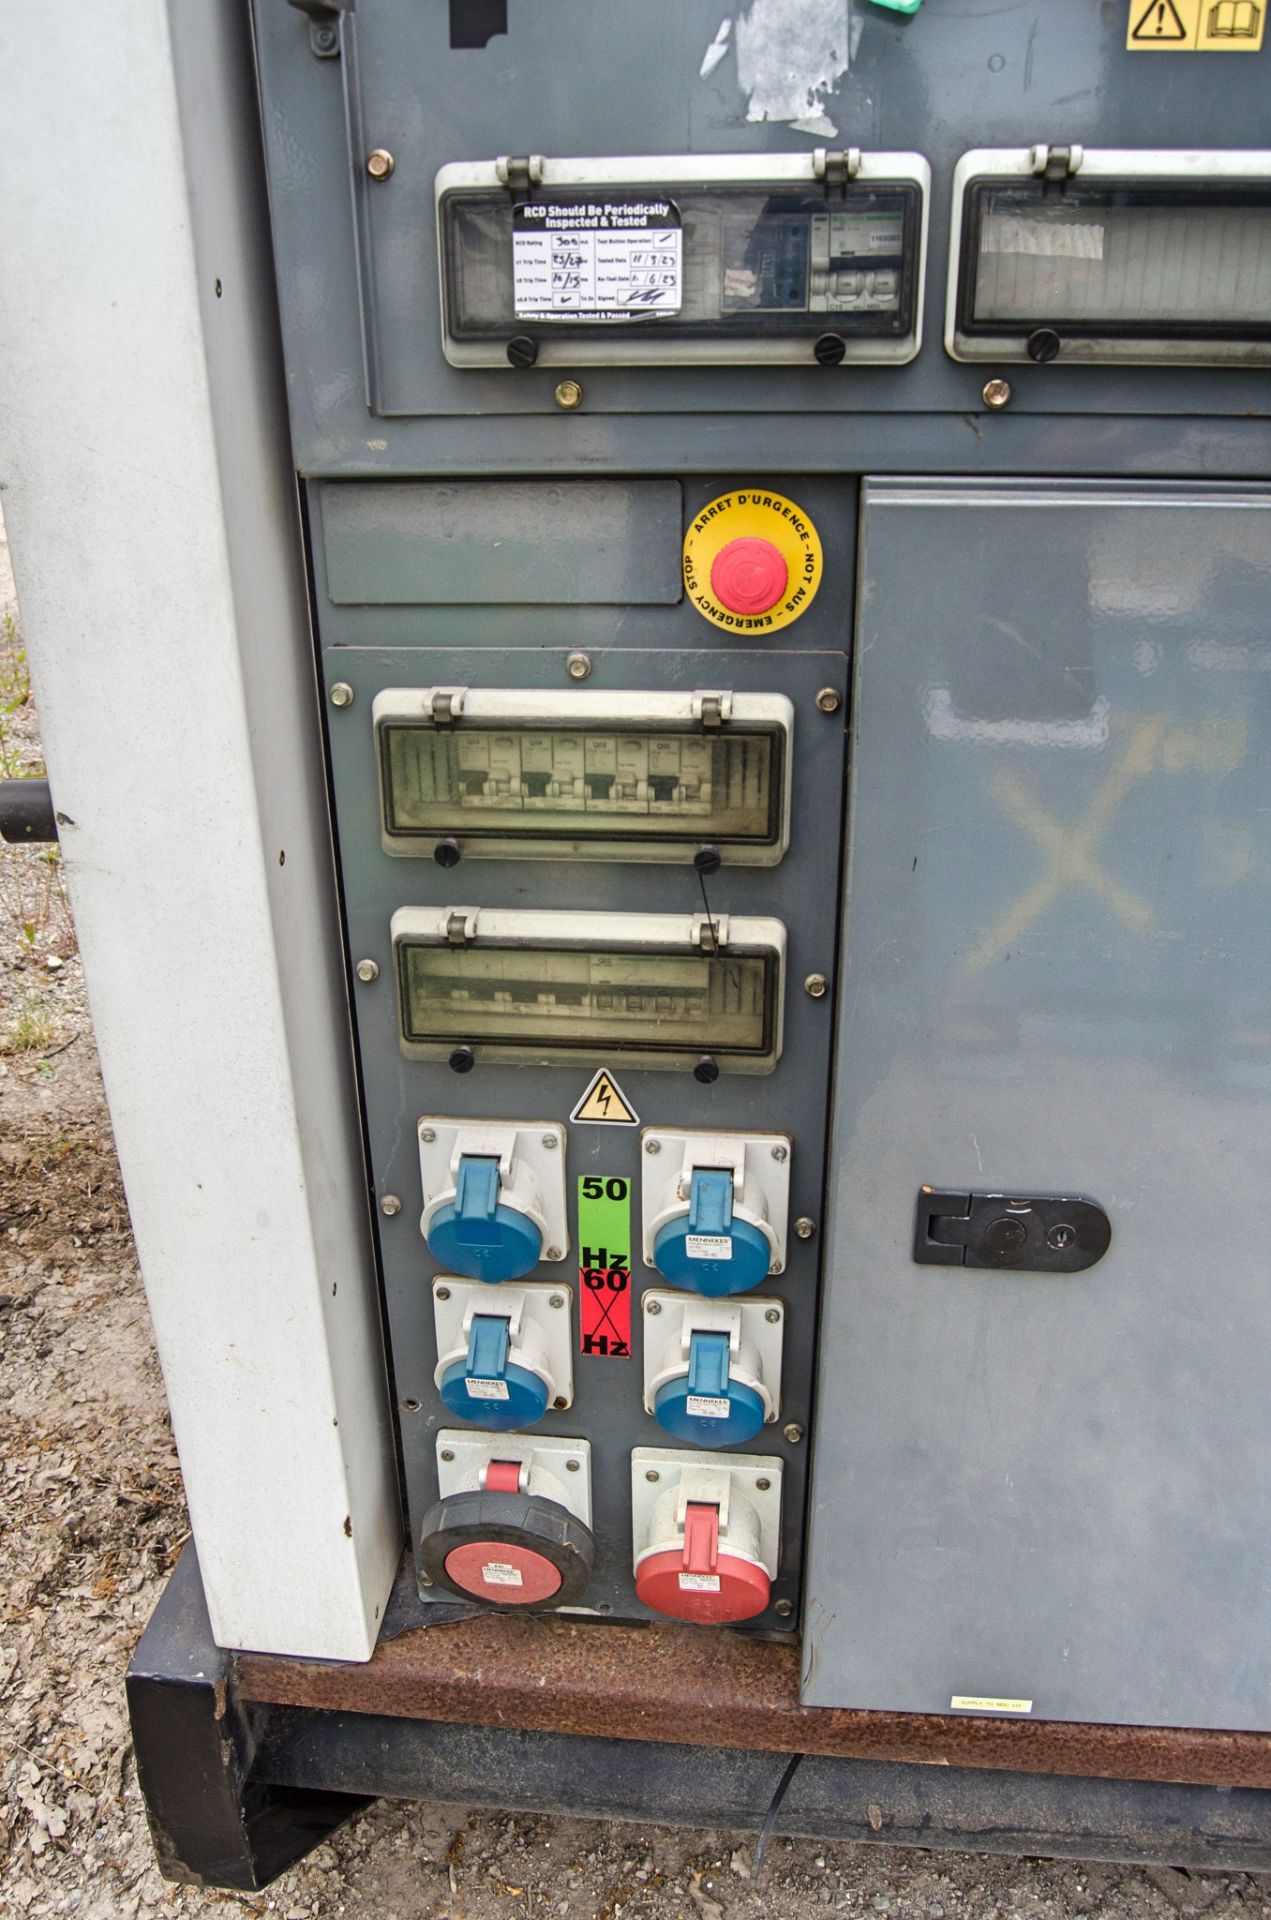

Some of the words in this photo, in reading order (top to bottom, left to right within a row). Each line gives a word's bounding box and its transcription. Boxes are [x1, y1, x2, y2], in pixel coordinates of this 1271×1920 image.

[524, 206, 546, 218] RCD
[549, 205, 586, 218] Should
[588, 205, 602, 216] Be
[604, 204, 670, 216] Periodically
[546, 216, 598, 229] Inspected
[600, 217, 609, 228] &
[611, 216, 648, 228] Tested
[694, 498, 732, 533] ARRET
[738, 494, 810, 541] D'URGENCE
[685, 556, 698, 590] STOP
[803, 554, 814, 584] NOT
[786, 586, 806, 612] AUS
[696, 595, 772, 628] EMERGENCY
[582, 1178, 628, 1201] 50
[582, 1247, 628, 1270] Hz
[584, 1269, 627, 1292] 60
[584, 1334, 628, 1356] Hz
